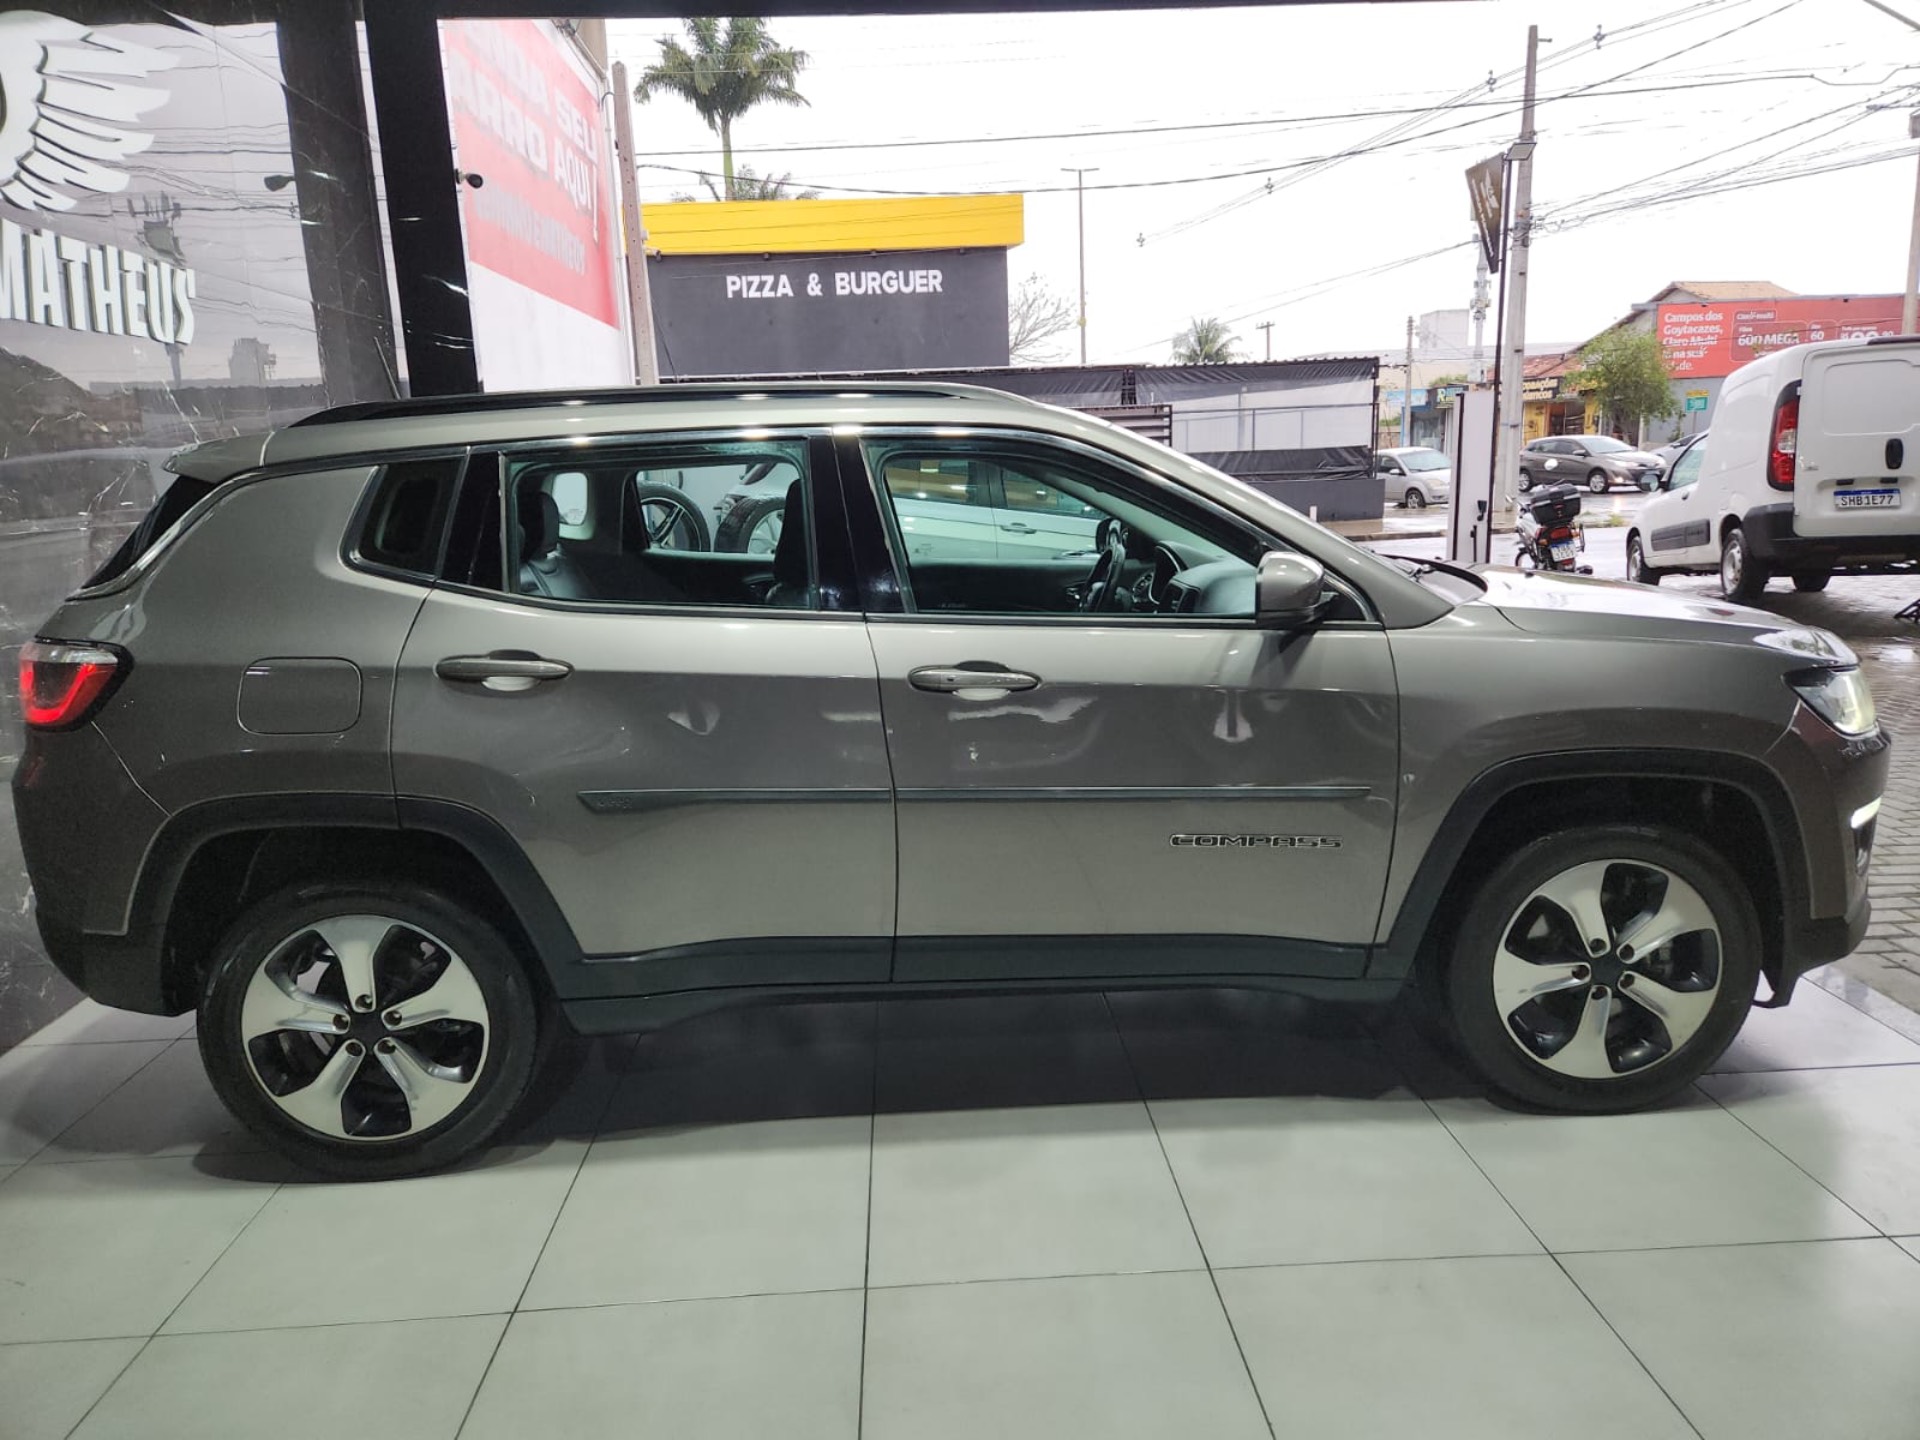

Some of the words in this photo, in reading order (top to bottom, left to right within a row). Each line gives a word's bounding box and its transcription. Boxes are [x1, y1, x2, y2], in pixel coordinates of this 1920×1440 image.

[726, 275, 793, 298] PIZZA
[806, 272, 822, 296] &
[834, 269, 943, 295] BURGUER
[1664, 313, 1704, 324] Campos
[1705, 310, 1723, 320] dos
[1663, 325, 1723, 336] Goytacazes,
[1810, 331, 1824, 340] 60
[1763, 332, 1799, 345] MEGA
[1841, 495, 1893, 506] SHB1E77
[1170, 834, 1343, 848] COMPASS
